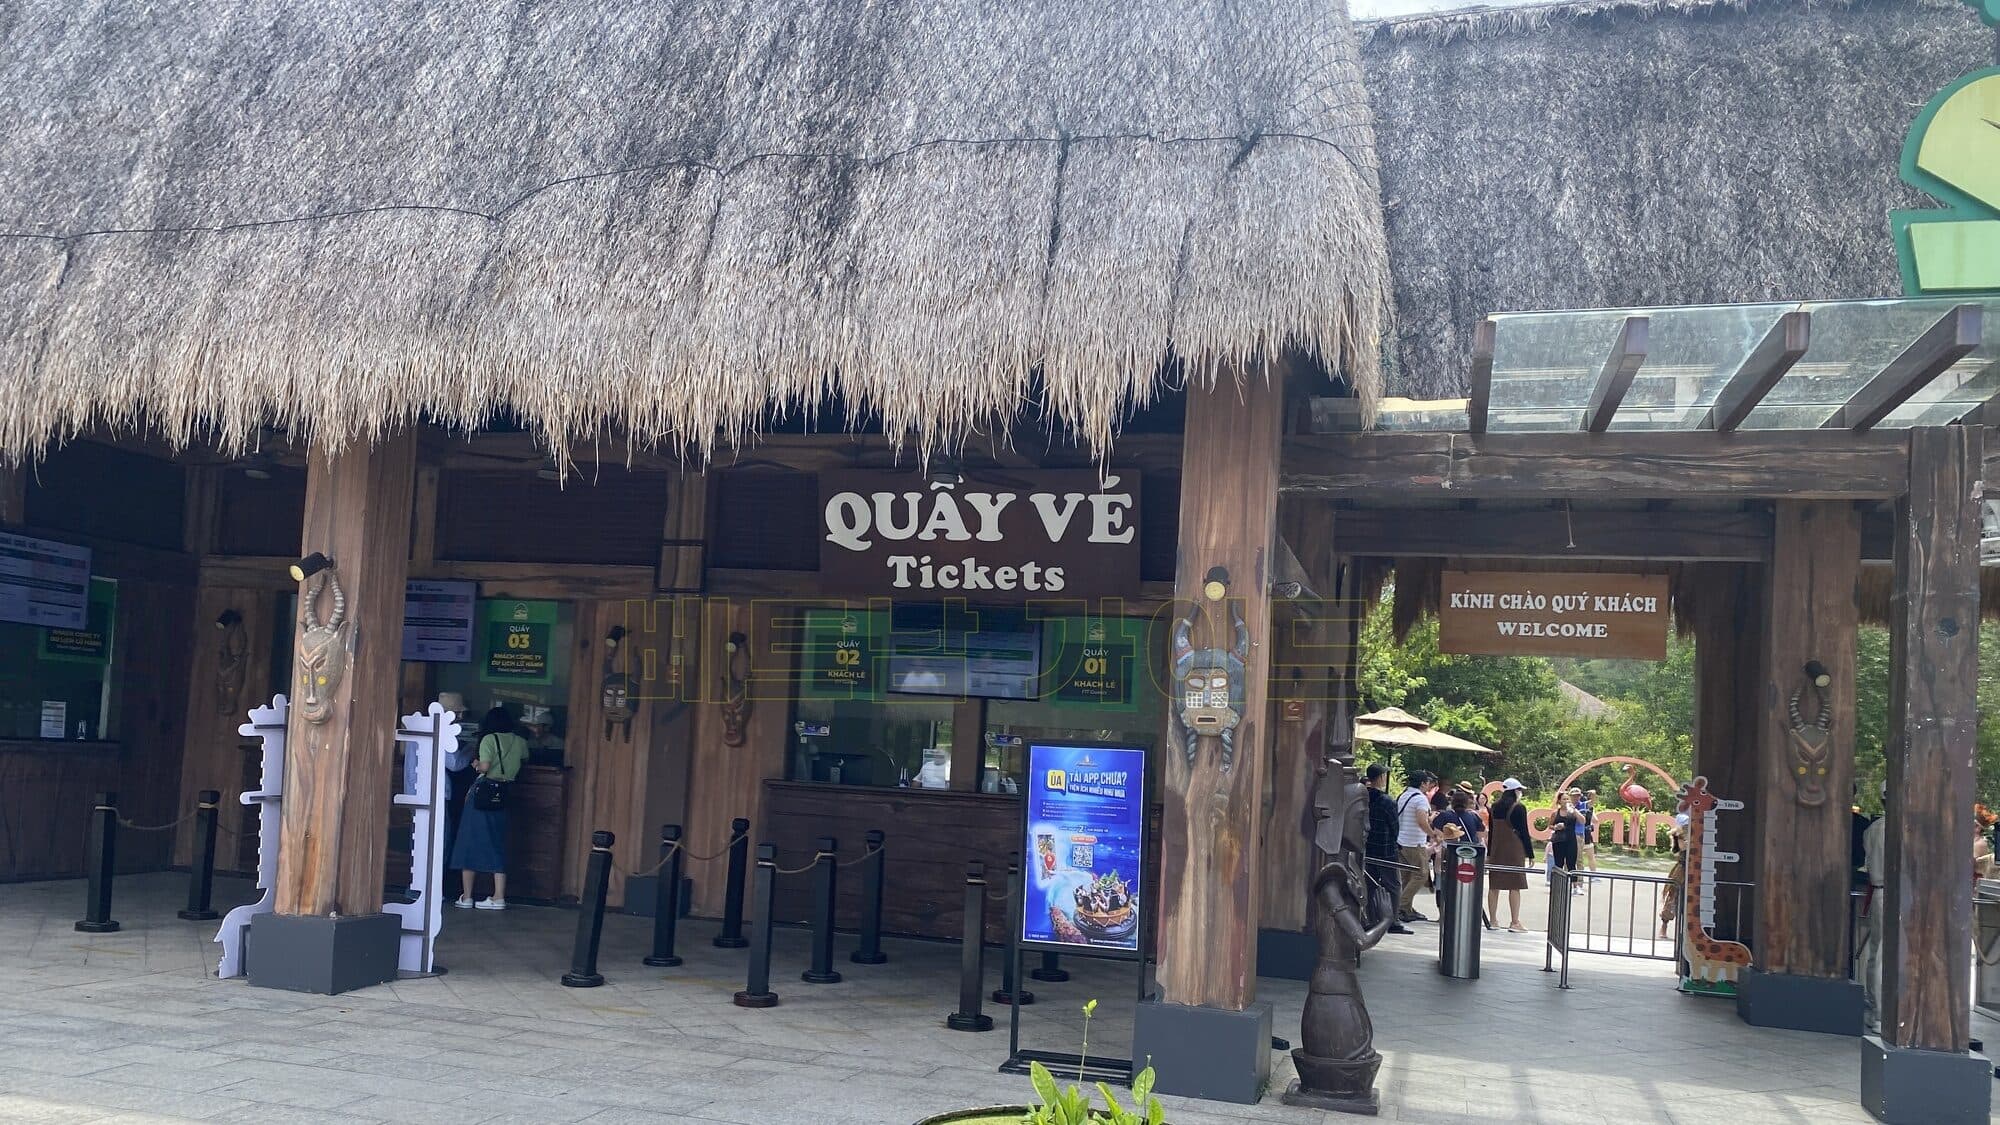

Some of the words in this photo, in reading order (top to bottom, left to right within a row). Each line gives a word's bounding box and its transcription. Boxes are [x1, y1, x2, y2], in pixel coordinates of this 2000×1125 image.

[1029, 475, 1135, 544] VÉ
[887, 555, 1065, 592] Tickets
[1450, 589, 1495, 609] KÍNH
[1499, 591, 1546, 610] CHÀO
[1552, 592, 1587, 614] QUÝ
[1594, 593, 1657, 613] KHÁCH
[1497, 621, 1608, 638] WELCOME
[509, 634, 530, 648] 03
[836, 650, 860, 665] 02
[1085, 658, 1107, 674] 01
[1083, 772, 1099, 784] APP
